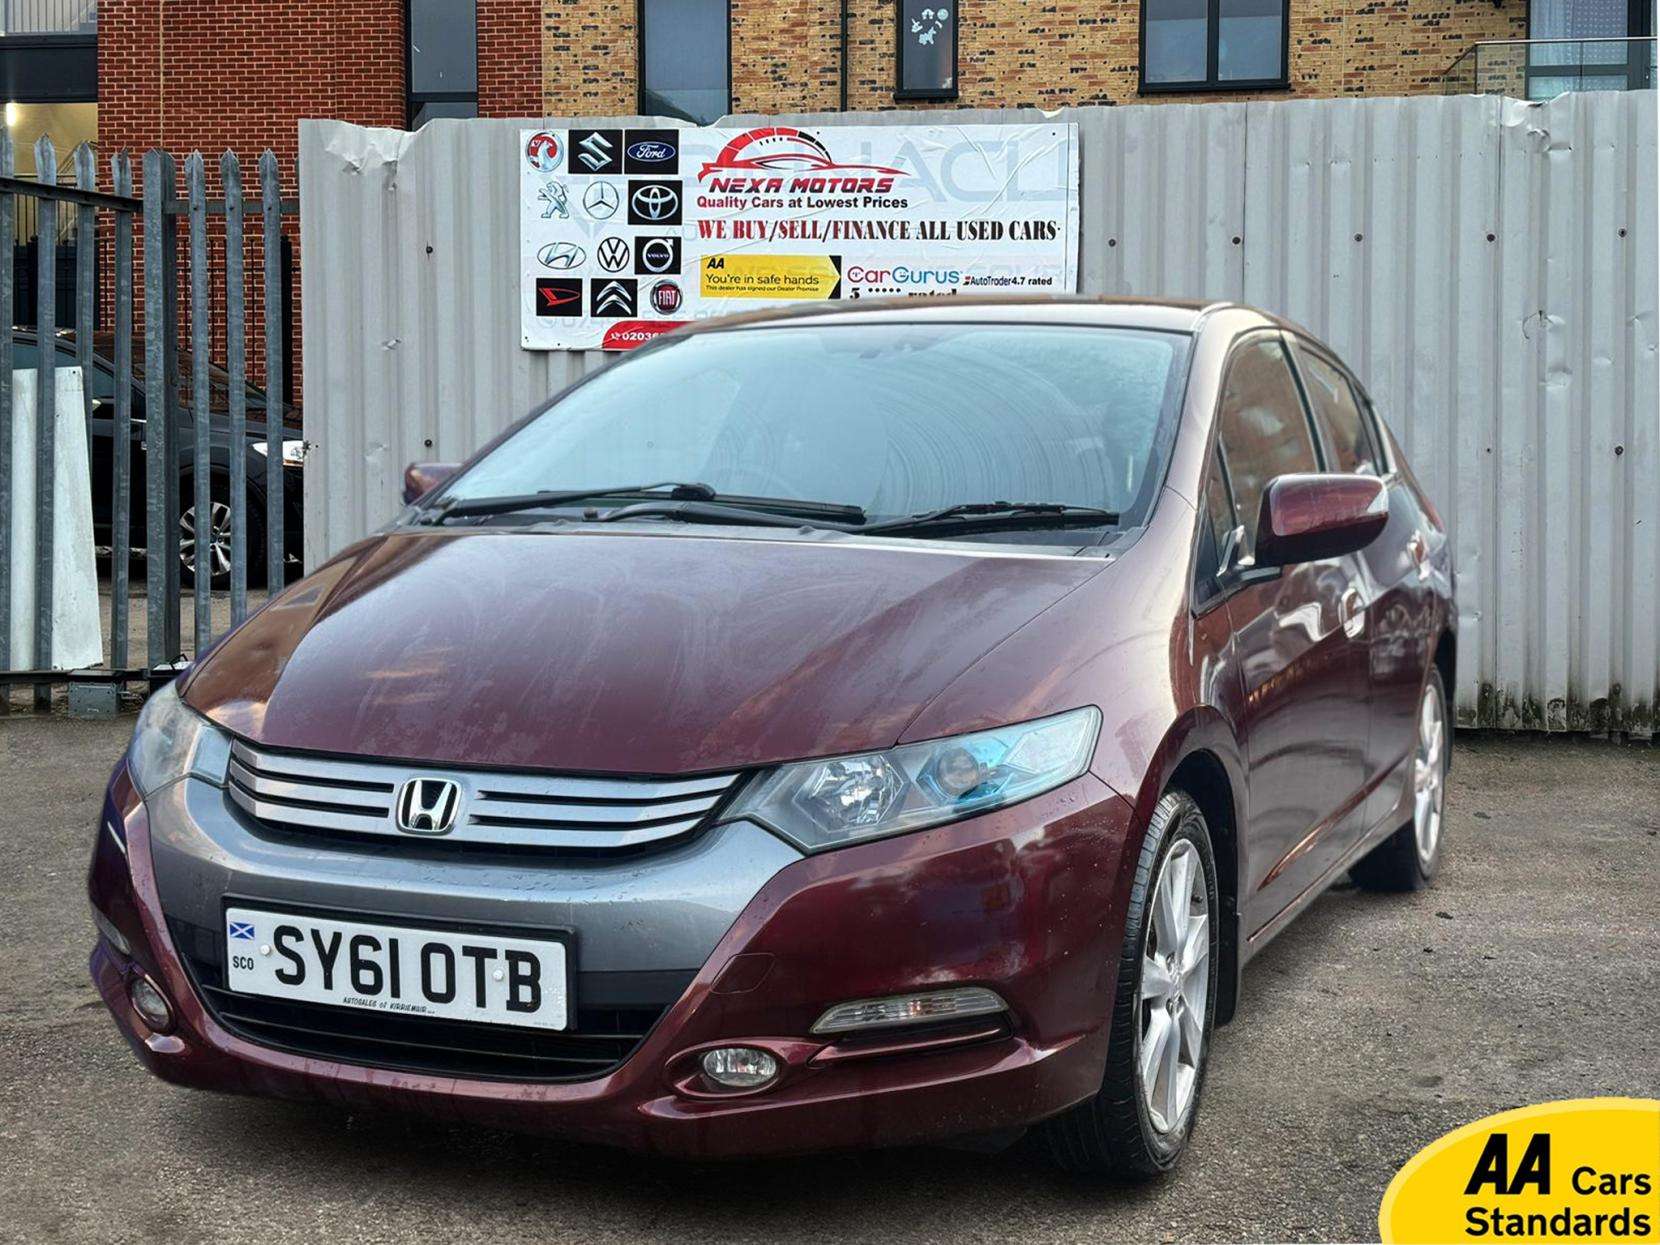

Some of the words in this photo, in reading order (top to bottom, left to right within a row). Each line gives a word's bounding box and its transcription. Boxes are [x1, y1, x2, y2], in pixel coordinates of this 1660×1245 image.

[636, 144, 666, 159] Ford
[708, 177, 784, 194] NEXA
[789, 177, 894, 194] MOTORS
[696, 196, 747, 210] Quality
[752, 196, 784, 208] Cars
[788, 197, 802, 208] at
[807, 196, 859, 208] Lowest
[863, 196, 908, 208] Prices
[697, 219, 727, 240] WE
[916, 220, 951, 241] ALL
[956, 220, 1004, 241] USED
[1008, 220, 1057, 241] CARS
[706, 257, 725, 269] AA
[705, 273, 741, 285] You're
[744, 273, 754, 285] in
[757, 274, 781, 285] safe
[783, 274, 820, 285] hands
[847, 266, 960, 284] CarGurus
[1028, 276, 1053, 286] rated
[658, 290, 676, 305] FIAT
[232, 955, 254, 971] SCO
[272, 924, 401, 999] SY61
[419, 941, 542, 1014] OTB
